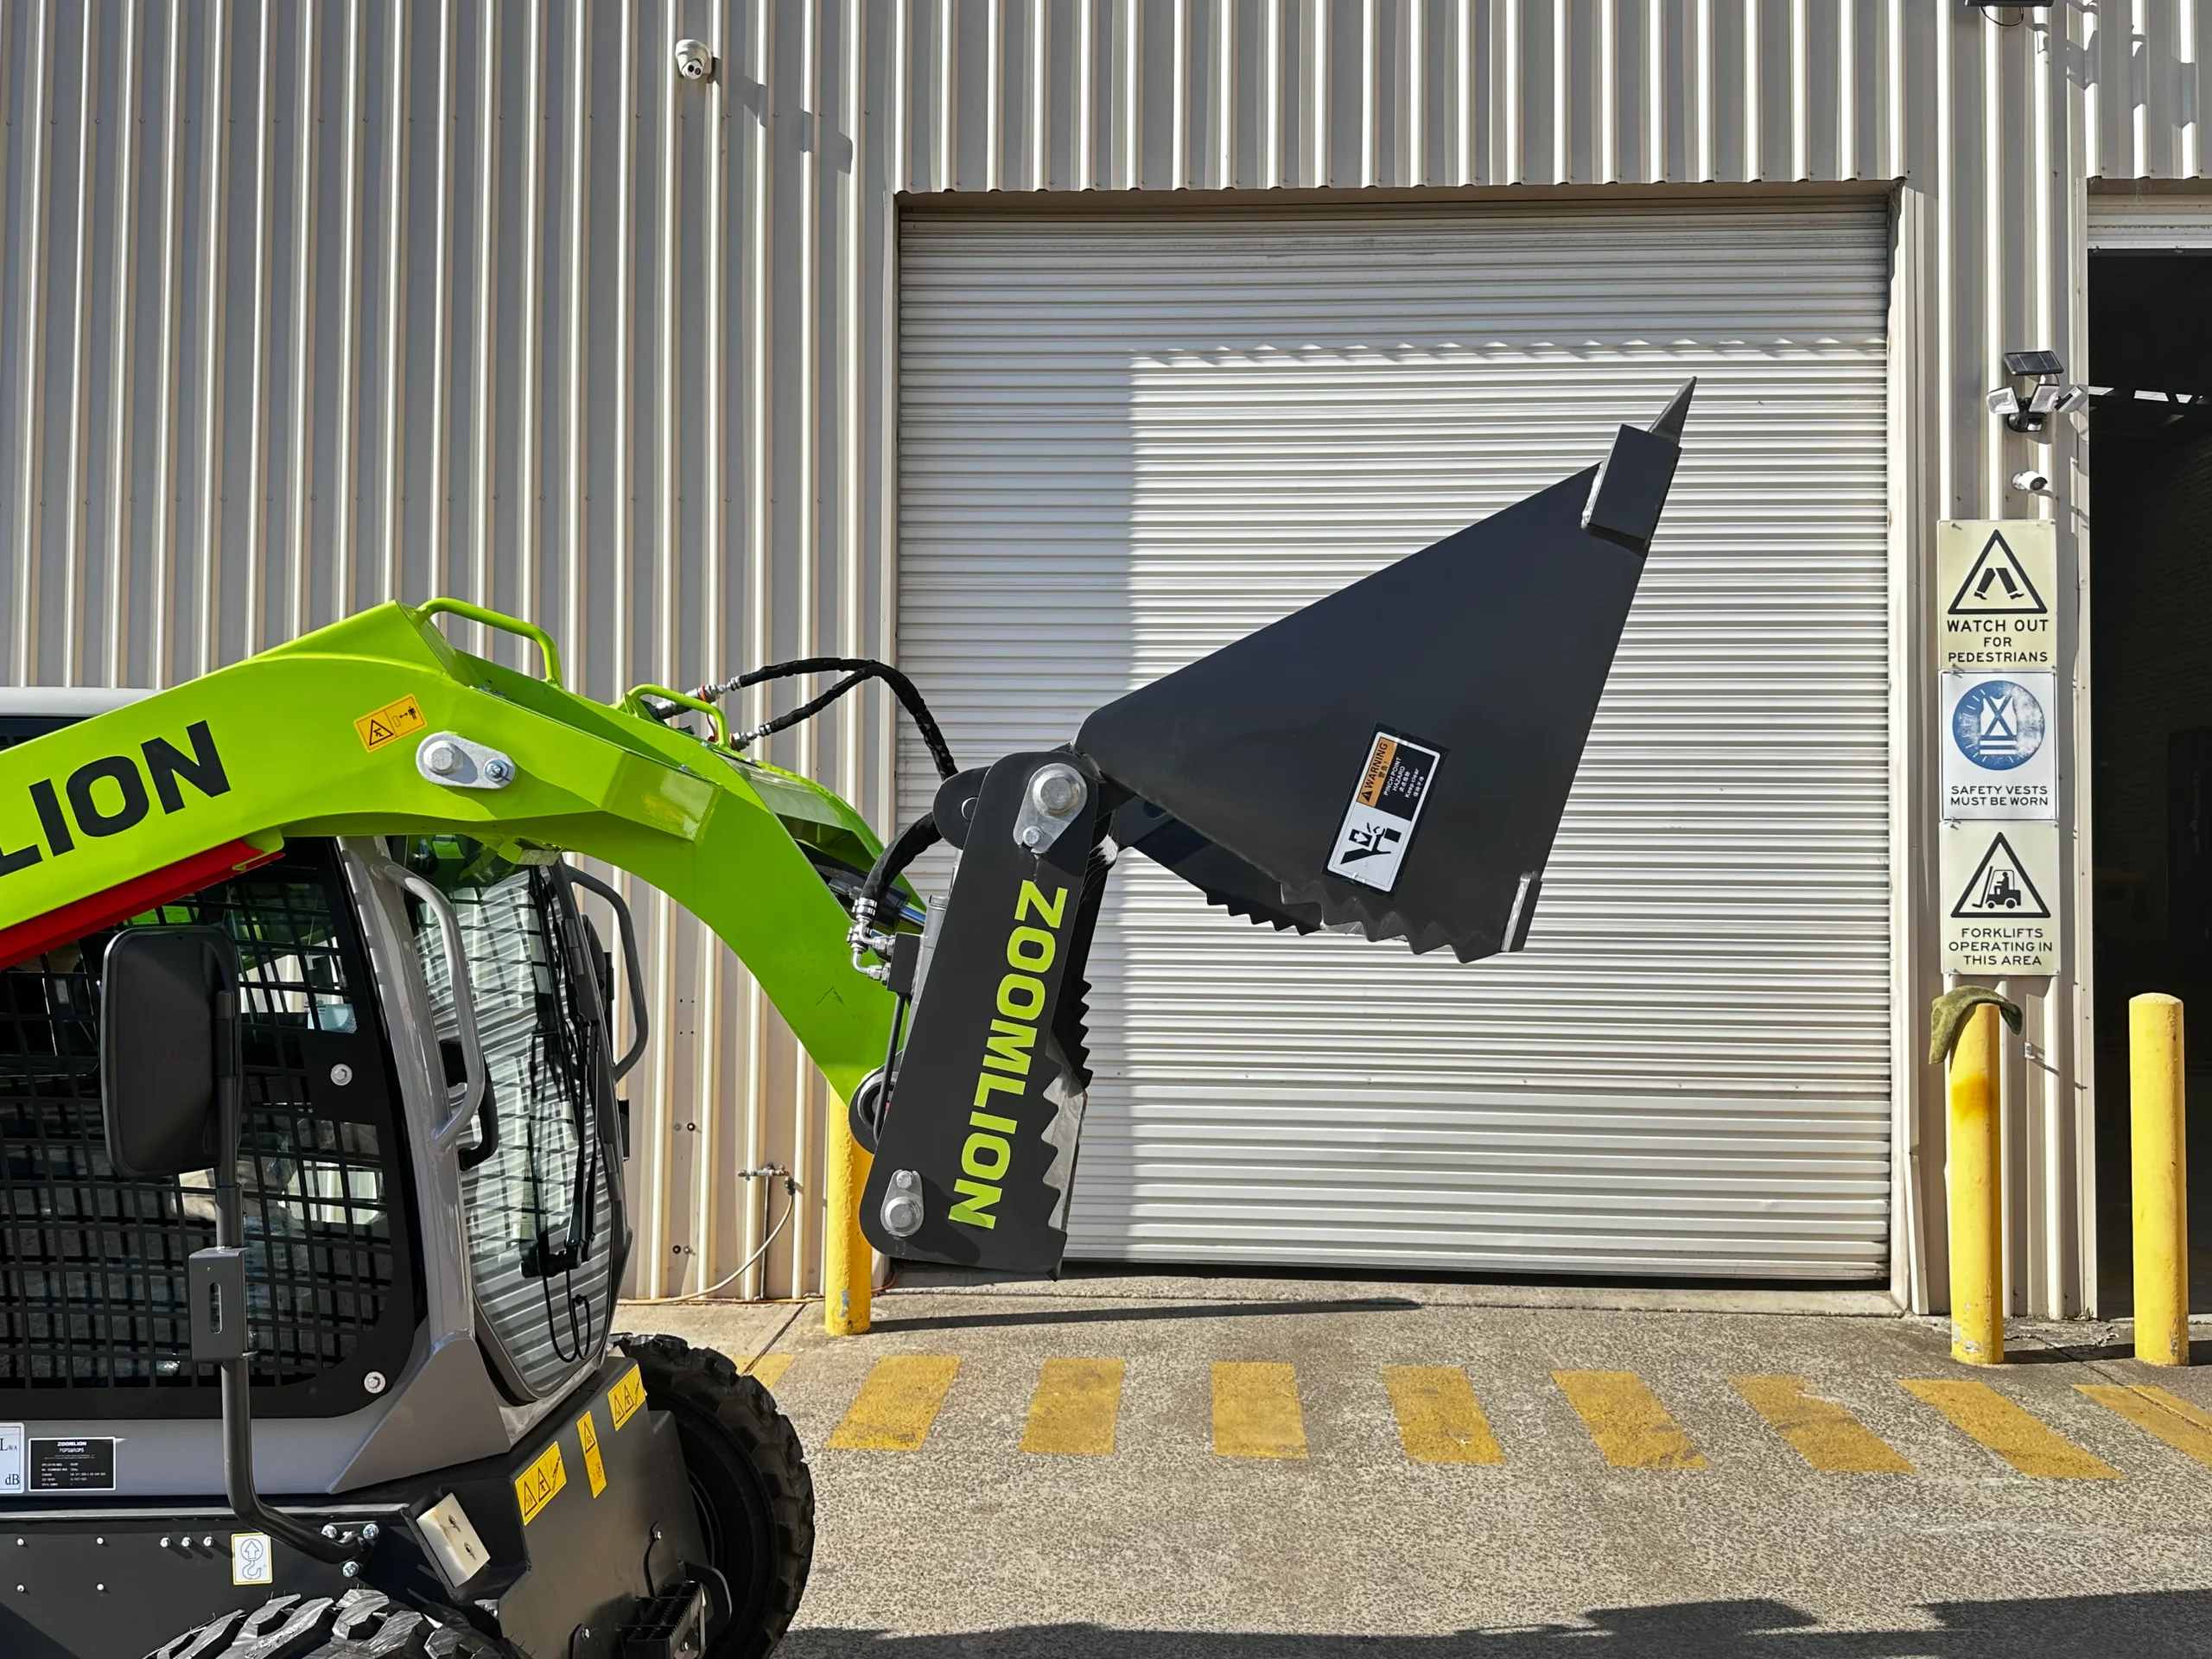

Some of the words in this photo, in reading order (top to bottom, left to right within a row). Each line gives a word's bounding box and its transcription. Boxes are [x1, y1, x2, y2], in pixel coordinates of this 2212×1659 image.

[1947, 620, 2005, 632] WATCH
[2014, 619, 2049, 632] OUT
[1984, 637, 2012, 647] FOR
[1948, 652, 2048, 663] PEDESTRIANS
[1364, 742, 1388, 789] WARNING
[1383, 775, 1395, 796] PINCH
[1390, 757, 1402, 777] POINT
[1392, 766, 1405, 791] HAZARD
[1404, 782, 1415, 798] Keep
[1411, 768, 1420, 783] clear
[1951, 785, 2003, 795] SAFETY
[2005, 785, 2048, 795] VESTS
[1950, 797, 1986, 805] MUST
[1990, 797, 2007, 805] BE
[2010, 797, 2048, 805] WORN
[1961, 928, 2044, 938] FORKLIFTS
[1948, 941, 2035, 951] OPERATING
[2038, 941, 2052, 951] IN
[1963, 955, 1997, 965] THIS
[2001, 955, 2042, 965] AREA
[948, 879, 1069, 1230] ZOOMLION
[5, 1474, 20, 1485] dB
